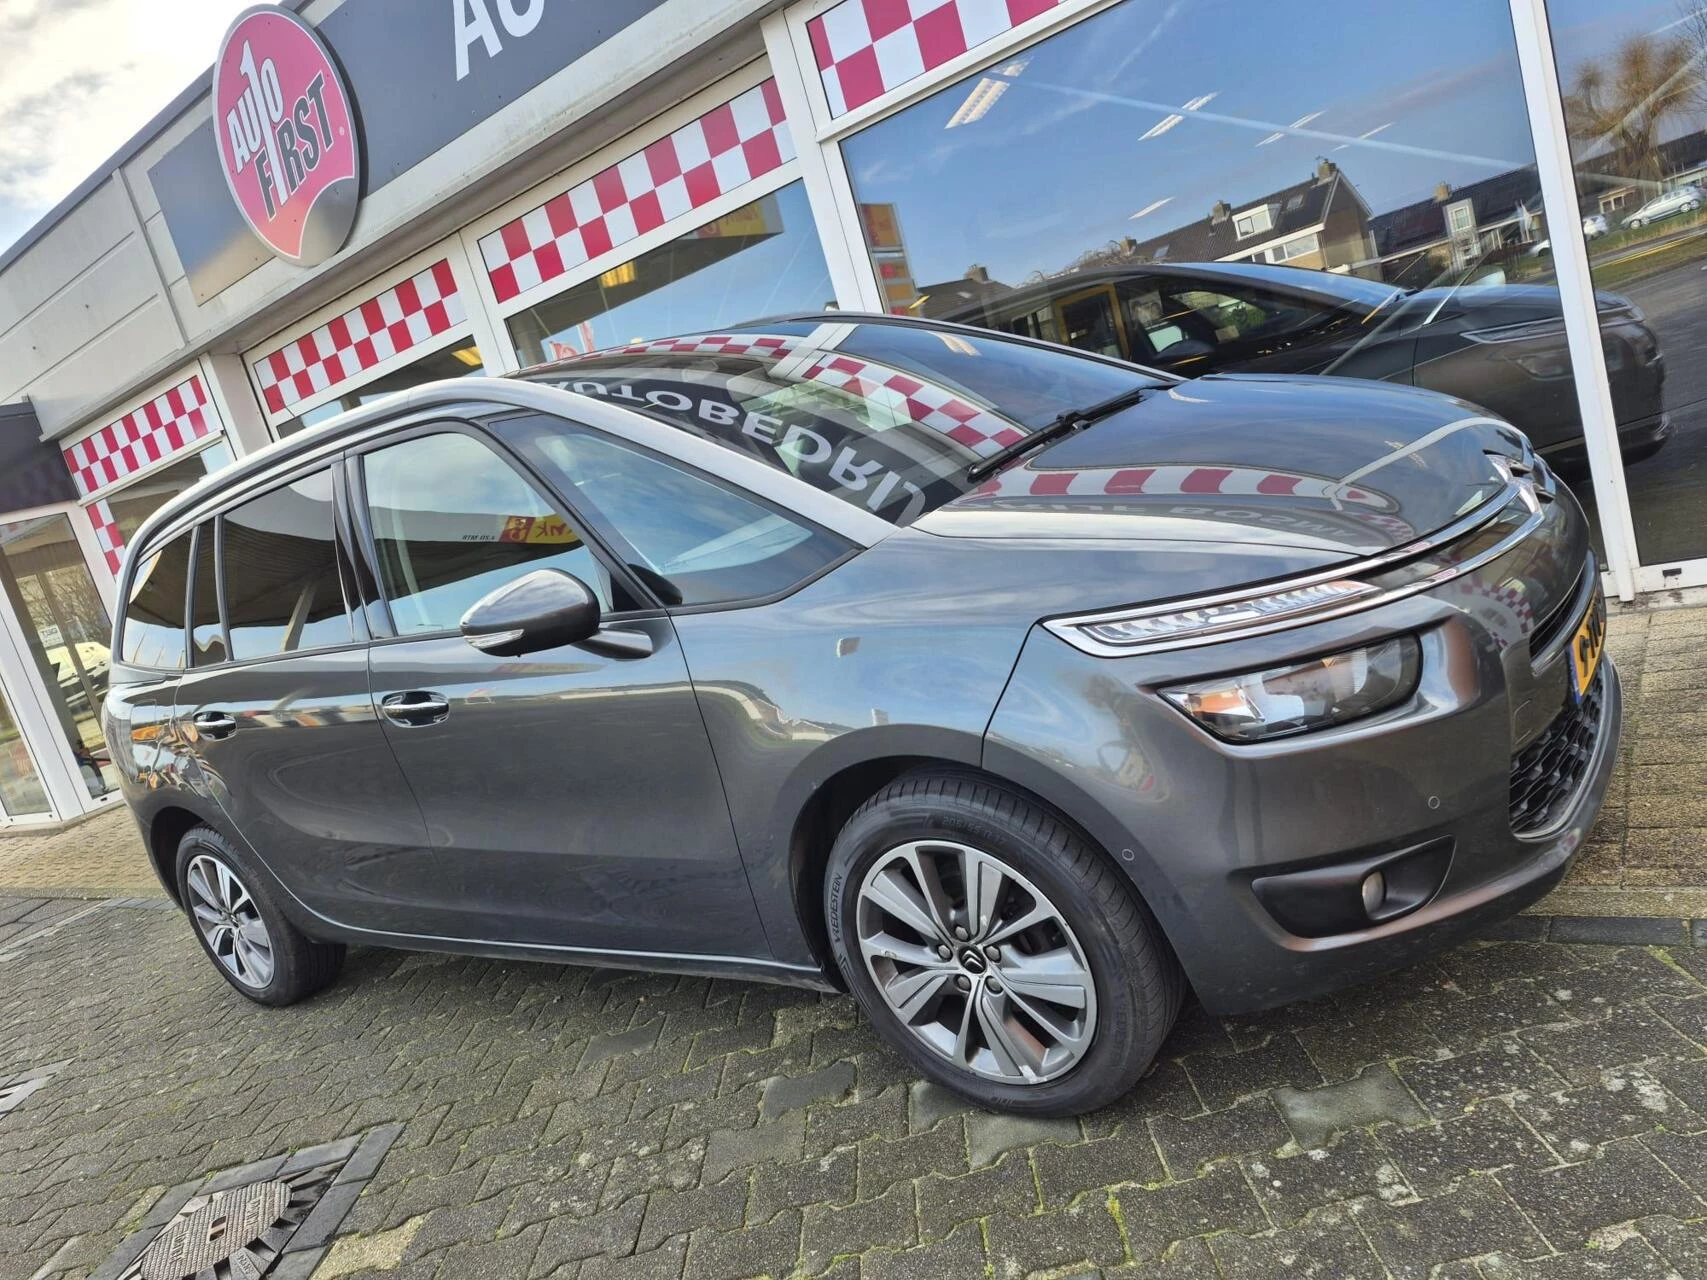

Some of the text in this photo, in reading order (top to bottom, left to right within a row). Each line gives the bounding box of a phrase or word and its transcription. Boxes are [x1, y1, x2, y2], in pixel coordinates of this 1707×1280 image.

[226, 40, 284, 175] AUTO
[254, 70, 334, 223] FIRST
[829, 872, 843, 943] VREDESTEIN
